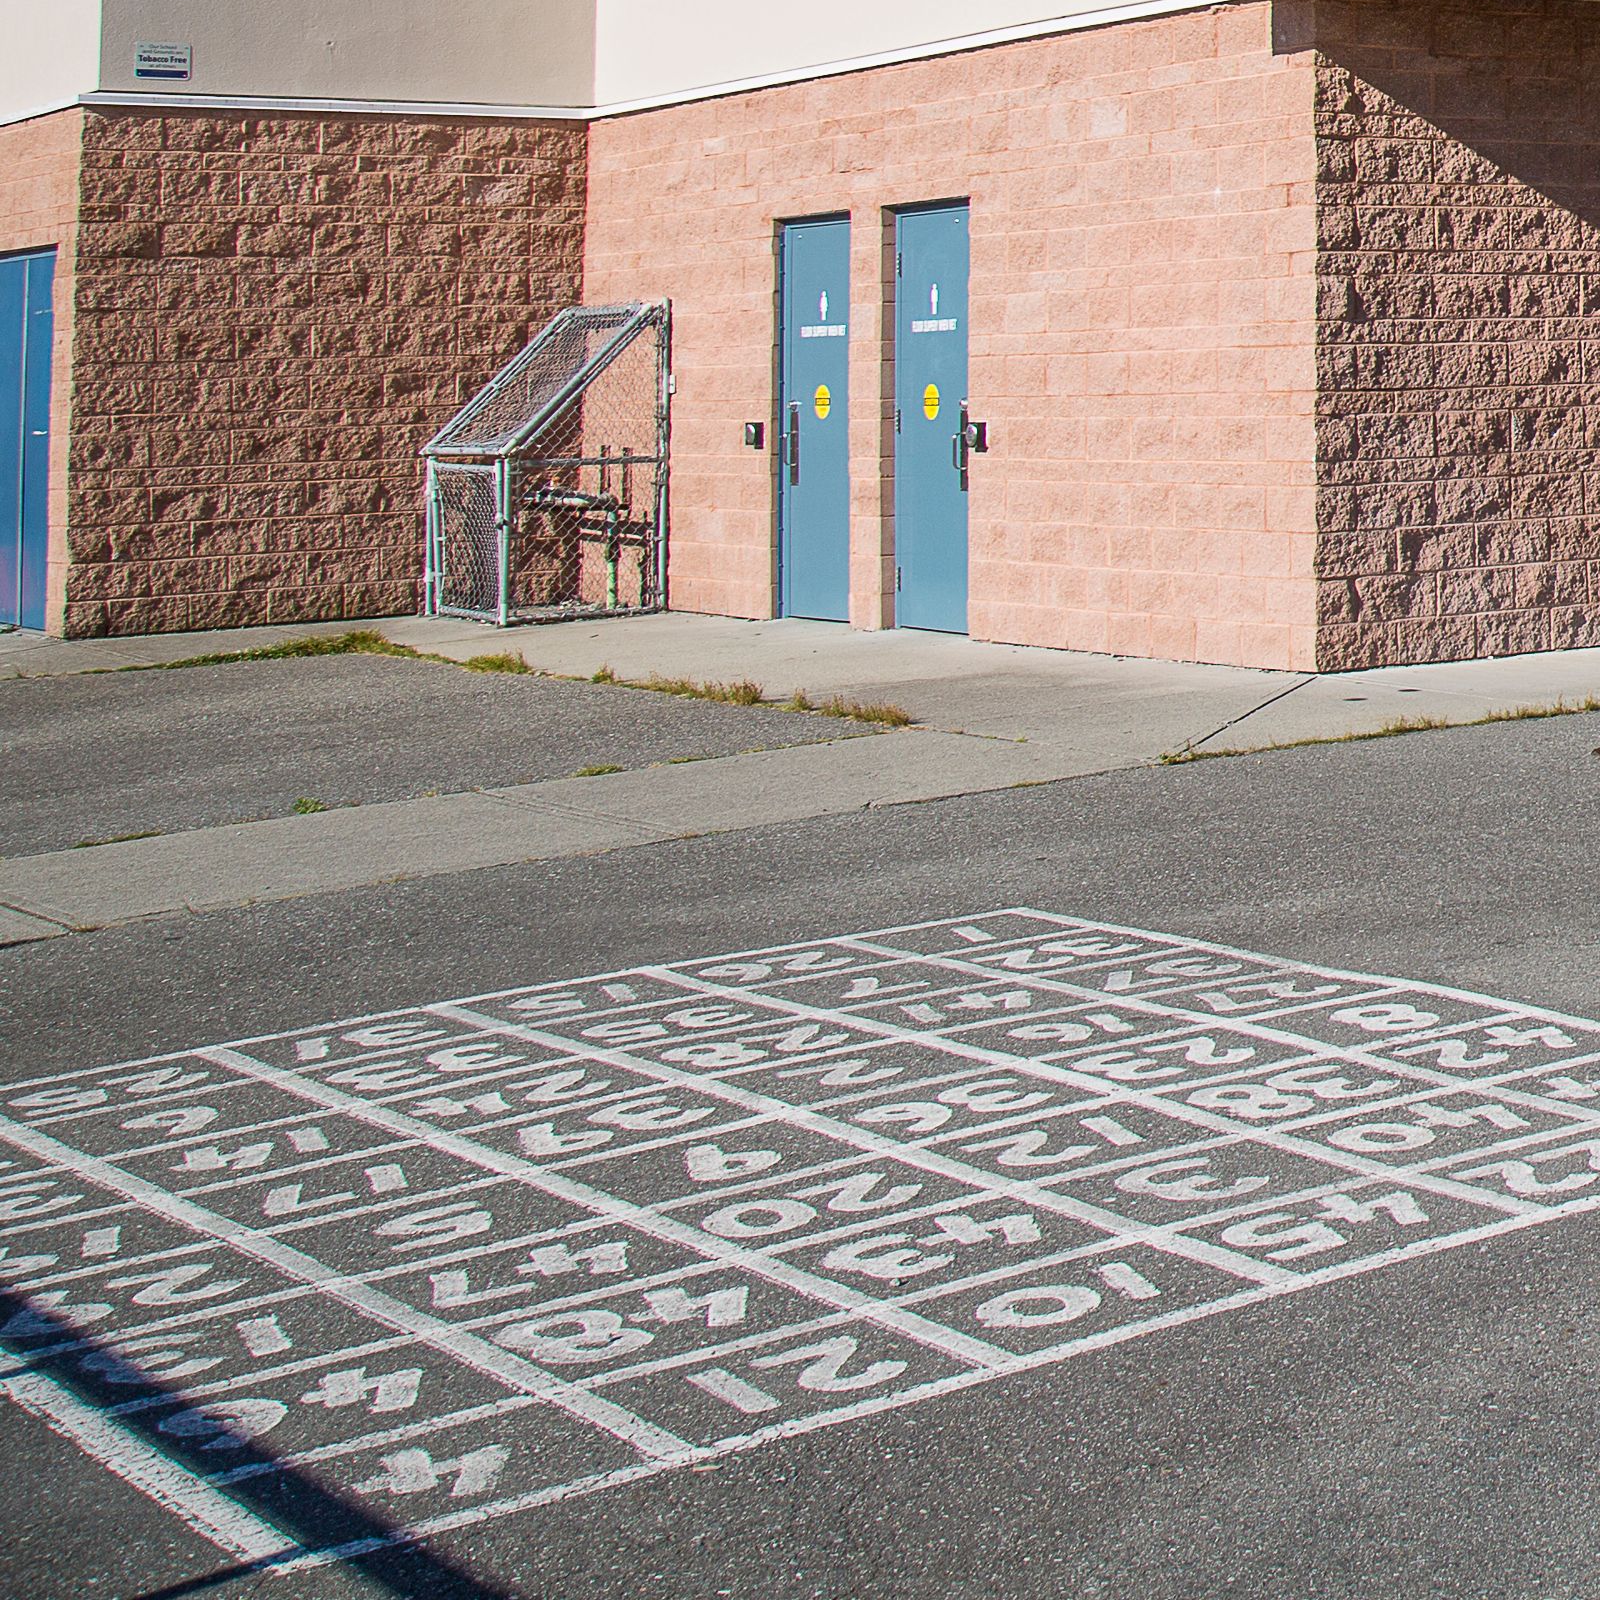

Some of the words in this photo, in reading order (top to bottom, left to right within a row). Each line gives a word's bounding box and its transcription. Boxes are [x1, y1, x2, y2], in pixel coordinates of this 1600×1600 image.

[137, 54, 169, 63] Tobacco
[170, 56, 188, 64] Free
[953, 926, 993, 942] 1
[972, 937, 1139, 969] 32
[699, 951, 852, 981] 26
[842, 977, 928, 998] 7
[1103, 957, 1241, 992] 37
[508, 984, 637, 1018] 15
[901, 990, 1030, 1022] 41
[1196, 981, 1340, 1012] 27
[1331, 1004, 1439, 1031] 8
[296, 1021, 444, 1061] 31
[582, 1005, 752, 1044] 35
[661, 1025, 848, 1067] 28
[1008, 1014, 1134, 1041] 16
[1393, 1026, 1575, 1068] 42
[326, 1043, 523, 1090] 33
[777, 1060, 903, 1086] 2
[1072, 1037, 1255, 1080] 23
[9, 1067, 208, 1116] 25
[410, 1070, 610, 1117] 24
[854, 1079, 1052, 1132] 36
[1188, 1066, 1399, 1119] 38
[169, 1127, 328, 1171] 14
[519, 1096, 714, 1156] 39
[962, 1116, 1141, 1166] 12
[1328, 1103, 1530, 1152] 40
[263, 1164, 407, 1216] 17
[1114, 1158, 1269, 1201] 3
[375, 1202, 491, 1251] 5
[701, 1172, 922, 1237] 20
[1221, 1191, 1428, 1260] 45
[822, 1214, 1041, 1281] 43
[429, 1241, 629, 1308] 47
[976, 1262, 1160, 1327] 10
[493, 1286, 748, 1363] 48
[78, 1313, 293, 1385] 13
[687, 1335, 907, 1413] 21
[157, 1367, 423, 1450] 46
[352, 1444, 510, 1497] 4
